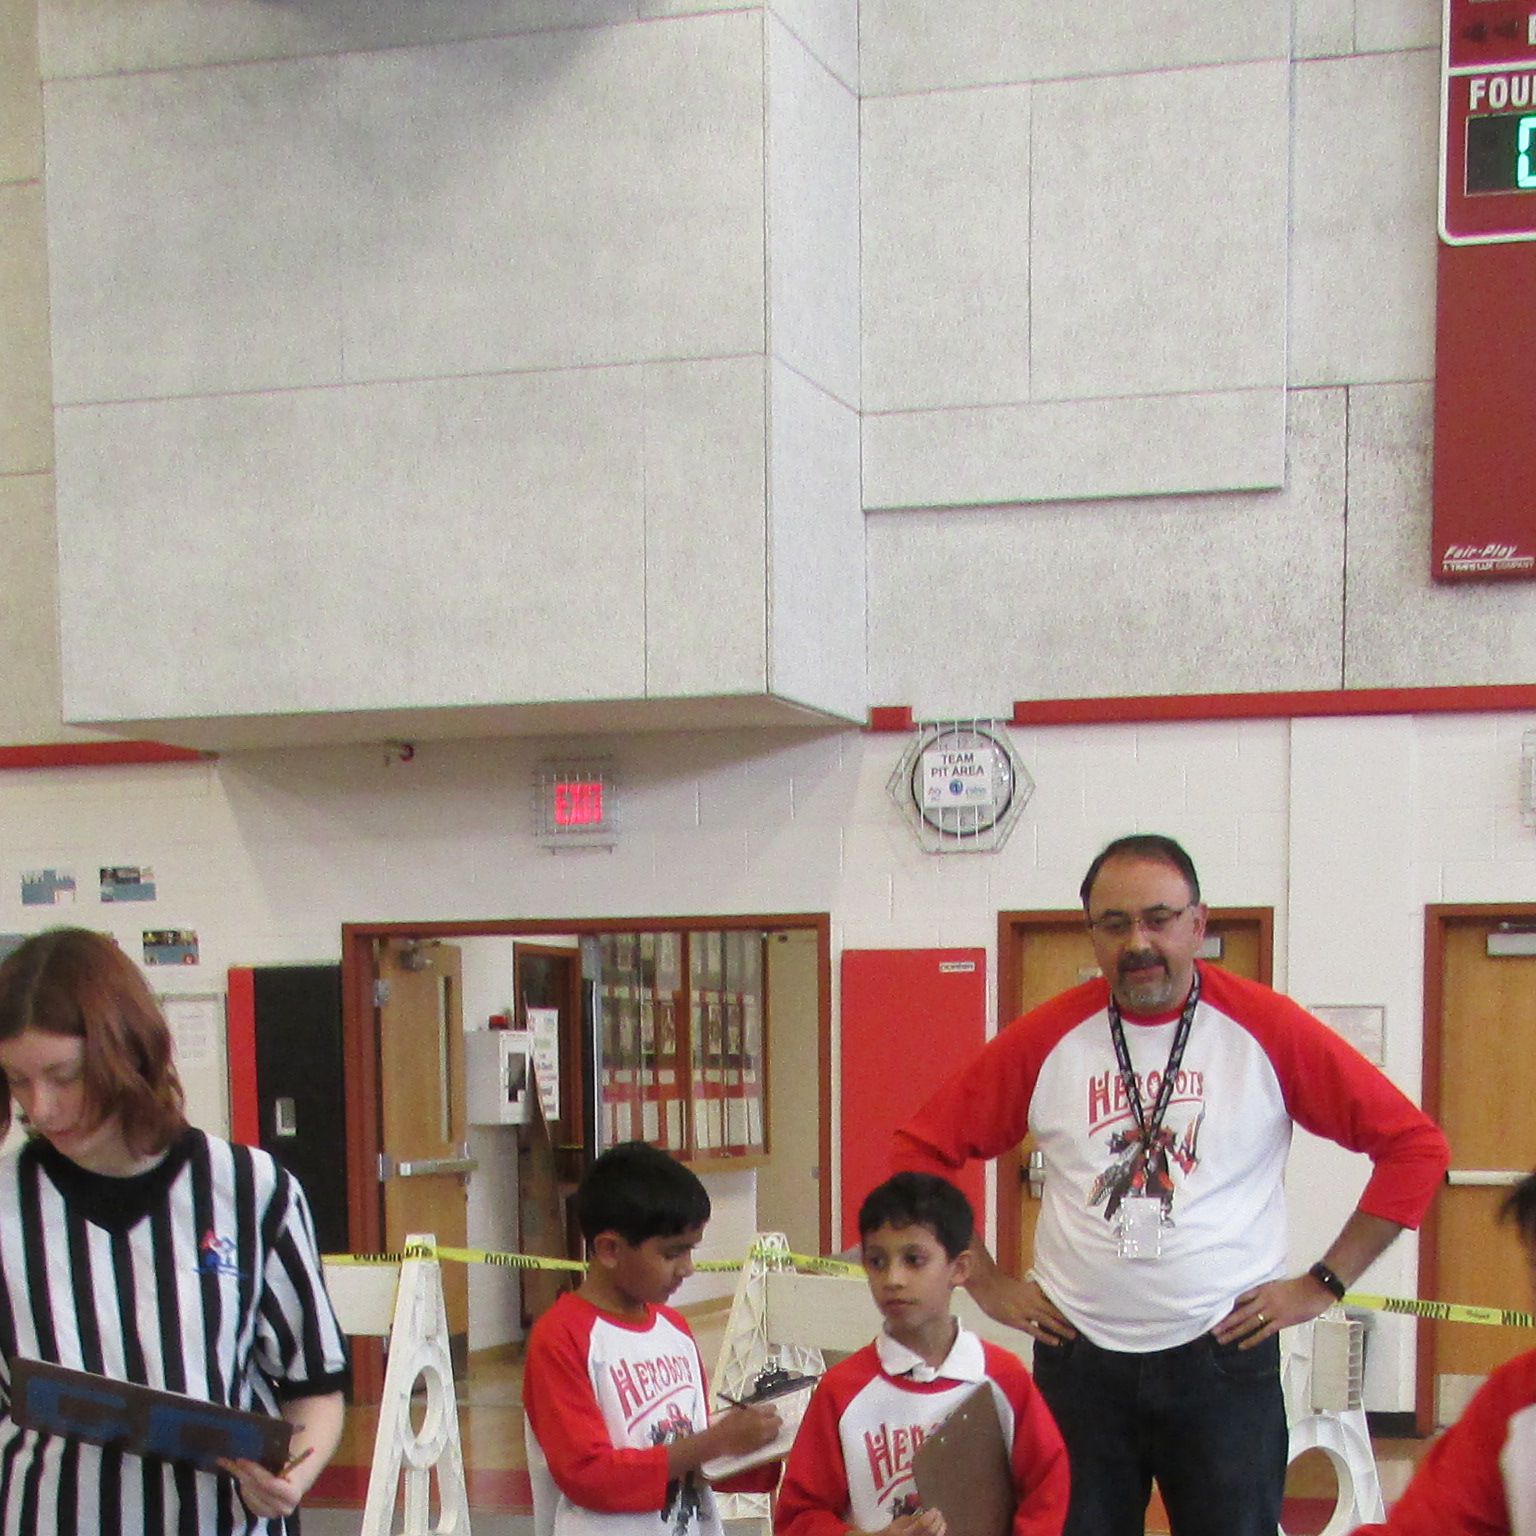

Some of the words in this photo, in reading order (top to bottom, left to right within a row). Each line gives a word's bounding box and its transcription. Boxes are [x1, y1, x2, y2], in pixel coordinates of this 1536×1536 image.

[1444, 544, 1517, 559] Fair-Play
[941, 753, 974, 765] TEAM
[931, 767, 948, 777] PIT
[951, 765, 984, 777] AREA
[555, 783, 602, 825] EXIT
